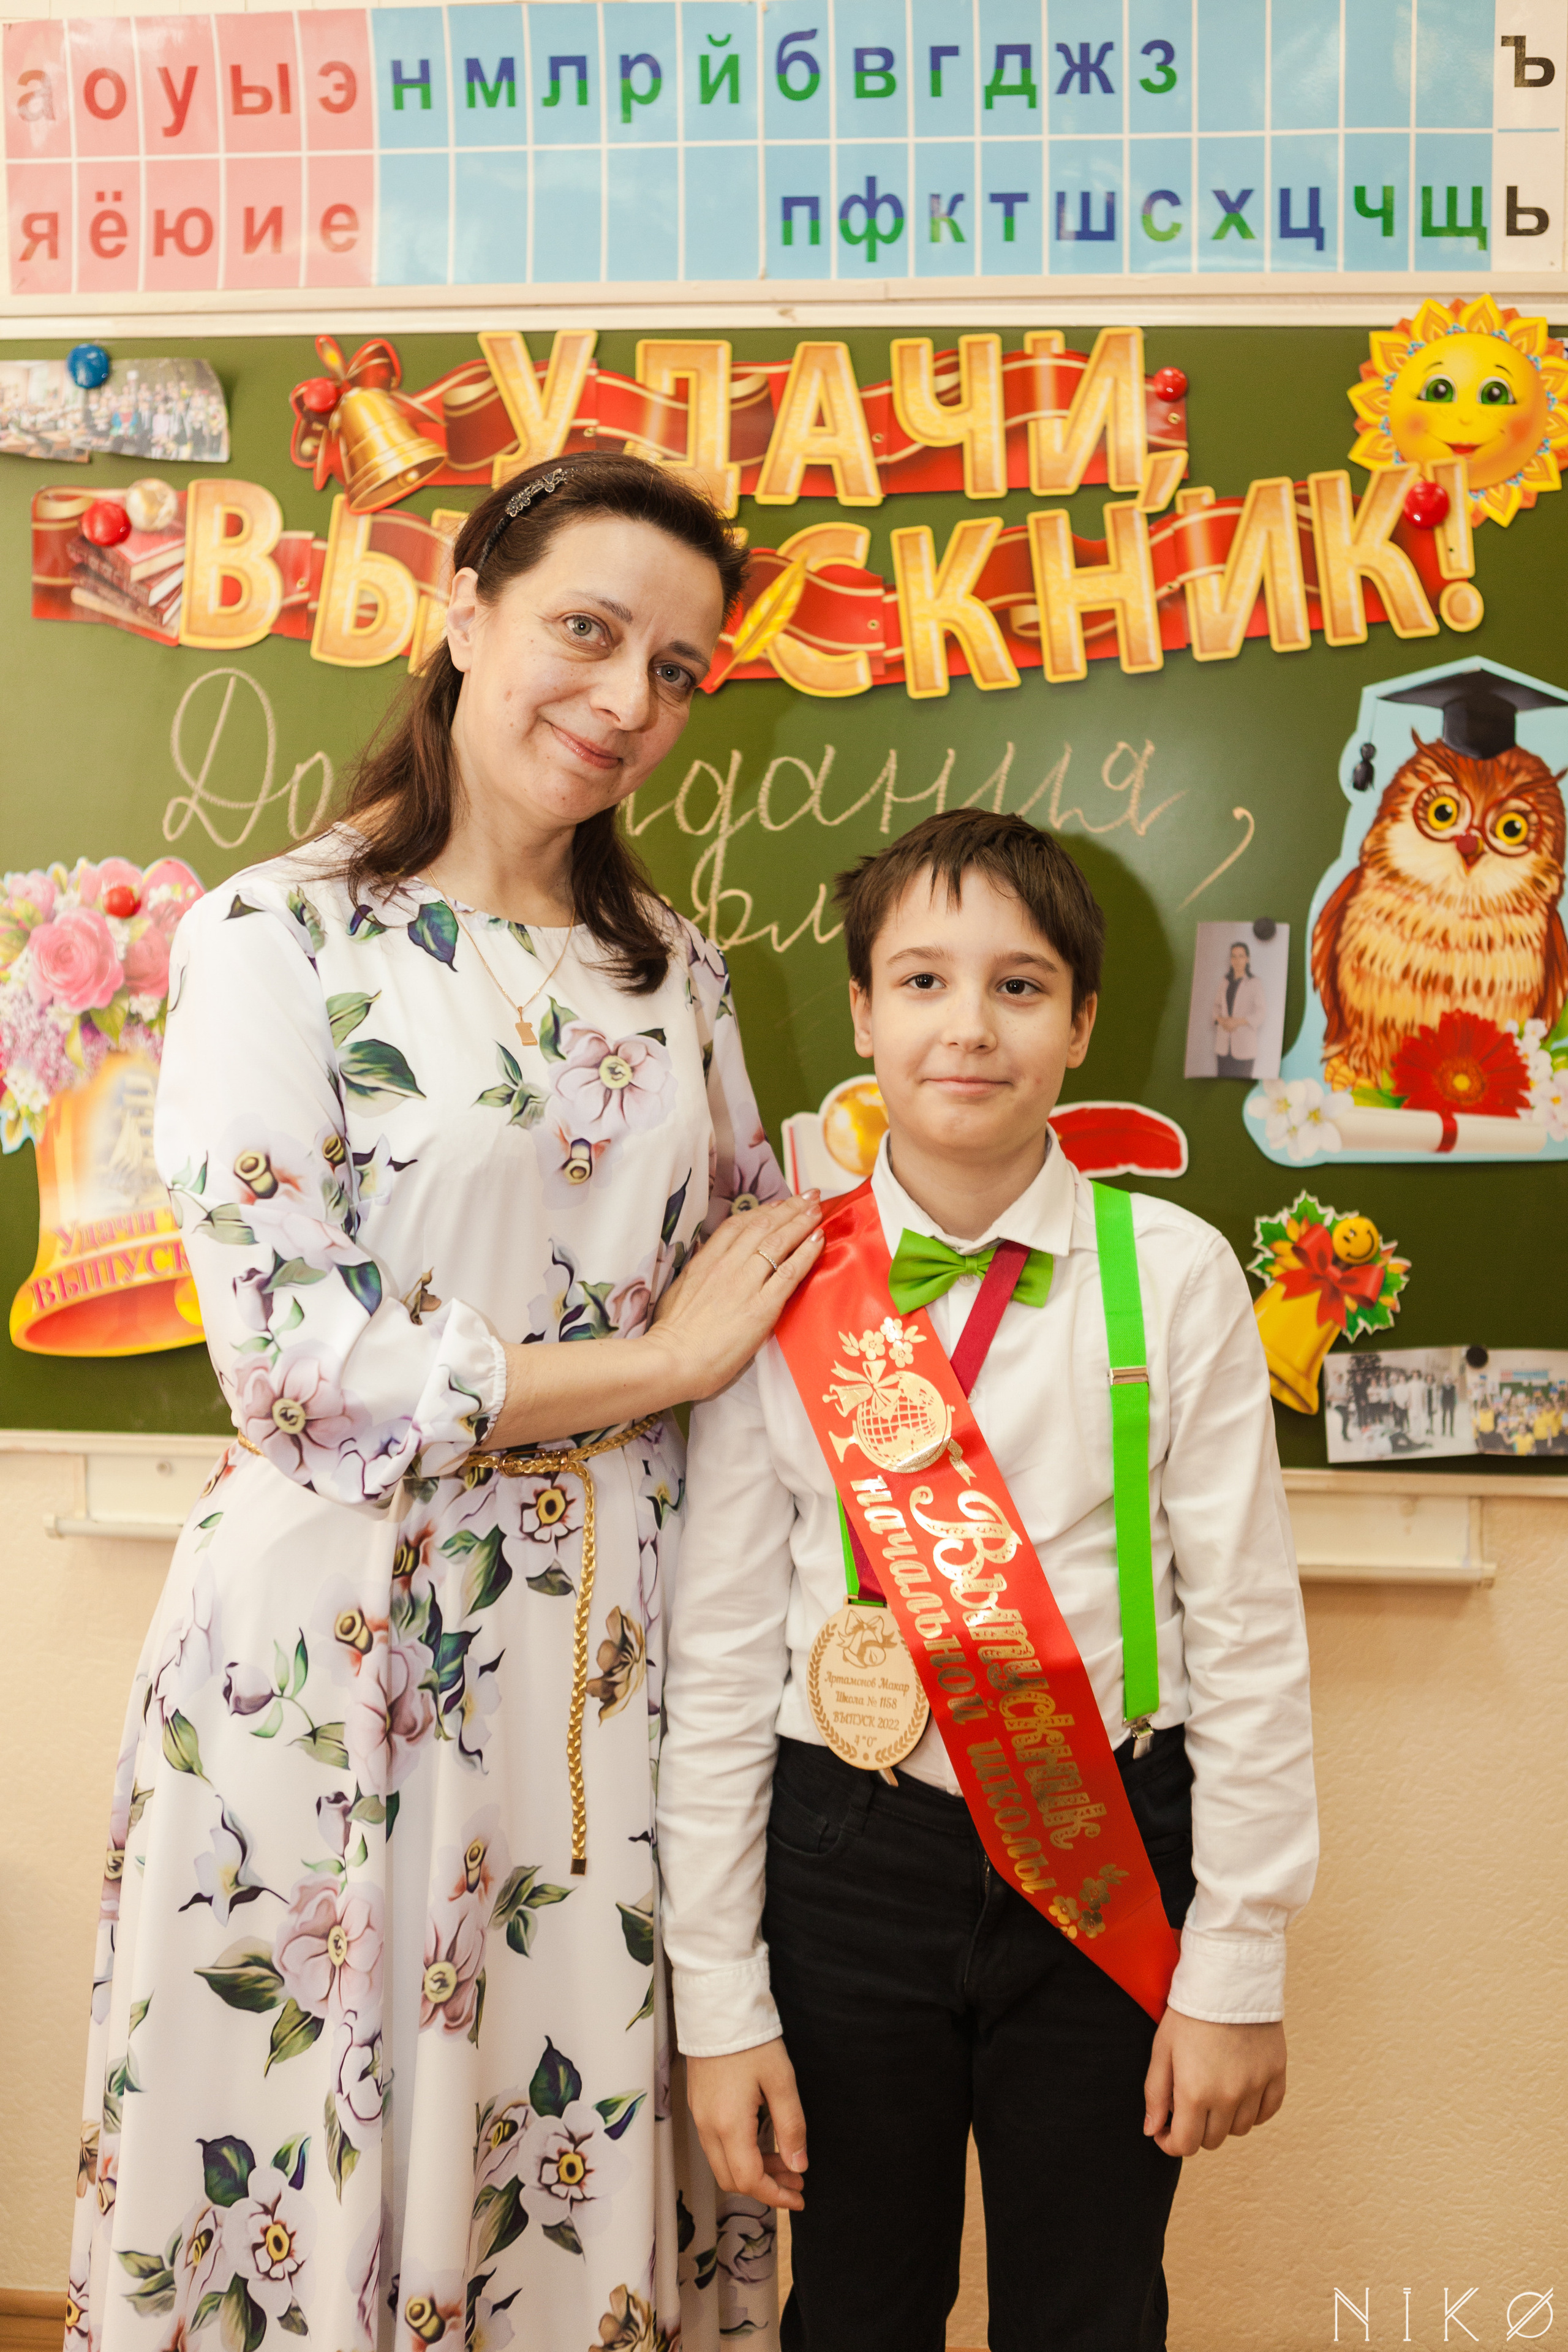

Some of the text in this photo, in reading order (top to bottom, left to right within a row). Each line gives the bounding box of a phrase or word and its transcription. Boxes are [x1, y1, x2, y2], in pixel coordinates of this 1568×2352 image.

[83, 68, 126, 120] о
[159, 66, 198, 137] у
[230, 63, 291, 115] ы
[319, 61, 358, 114] э
[391, 59, 431, 110] н
[465, 57, 516, 108] м
[542, 55, 588, 107] л
[619, 53, 662, 123] р
[699, 34, 740, 105] й
[775, 28, 820, 101] б
[853, 47, 897, 99] в
[929, 45, 960, 97] г
[984, 43, 1037, 110] д
[1055, 42, 1115, 95] ж
[1139, 39, 1177, 94] з
[1501, 36, 1555, 88] ъ
[20, 176, 1550, 262] я ё ю и е п ф к т ш с х ц ч щ ь
[478, 328, 1188, 519] УДАЧИ,
[179, 456, 1485, 698] ВЫСКНИК!
[162, 666, 1254, 913] До дания,
[31, 1242, 191, 1312] ВЫПУСК
[53, 1208, 157, 1256] Удачи
[824, 1670, 910, 1697] Артамонов Макар
[835, 1691, 864, 1705] Школа
[880, 1697, 898, 1709] 1158
[850, 1475, 1057, 1895] начальной школы
[909, 1485, 1107, 1850] Выпускник
[833, 1711, 900, 1731] ВЫПУСК 2022
